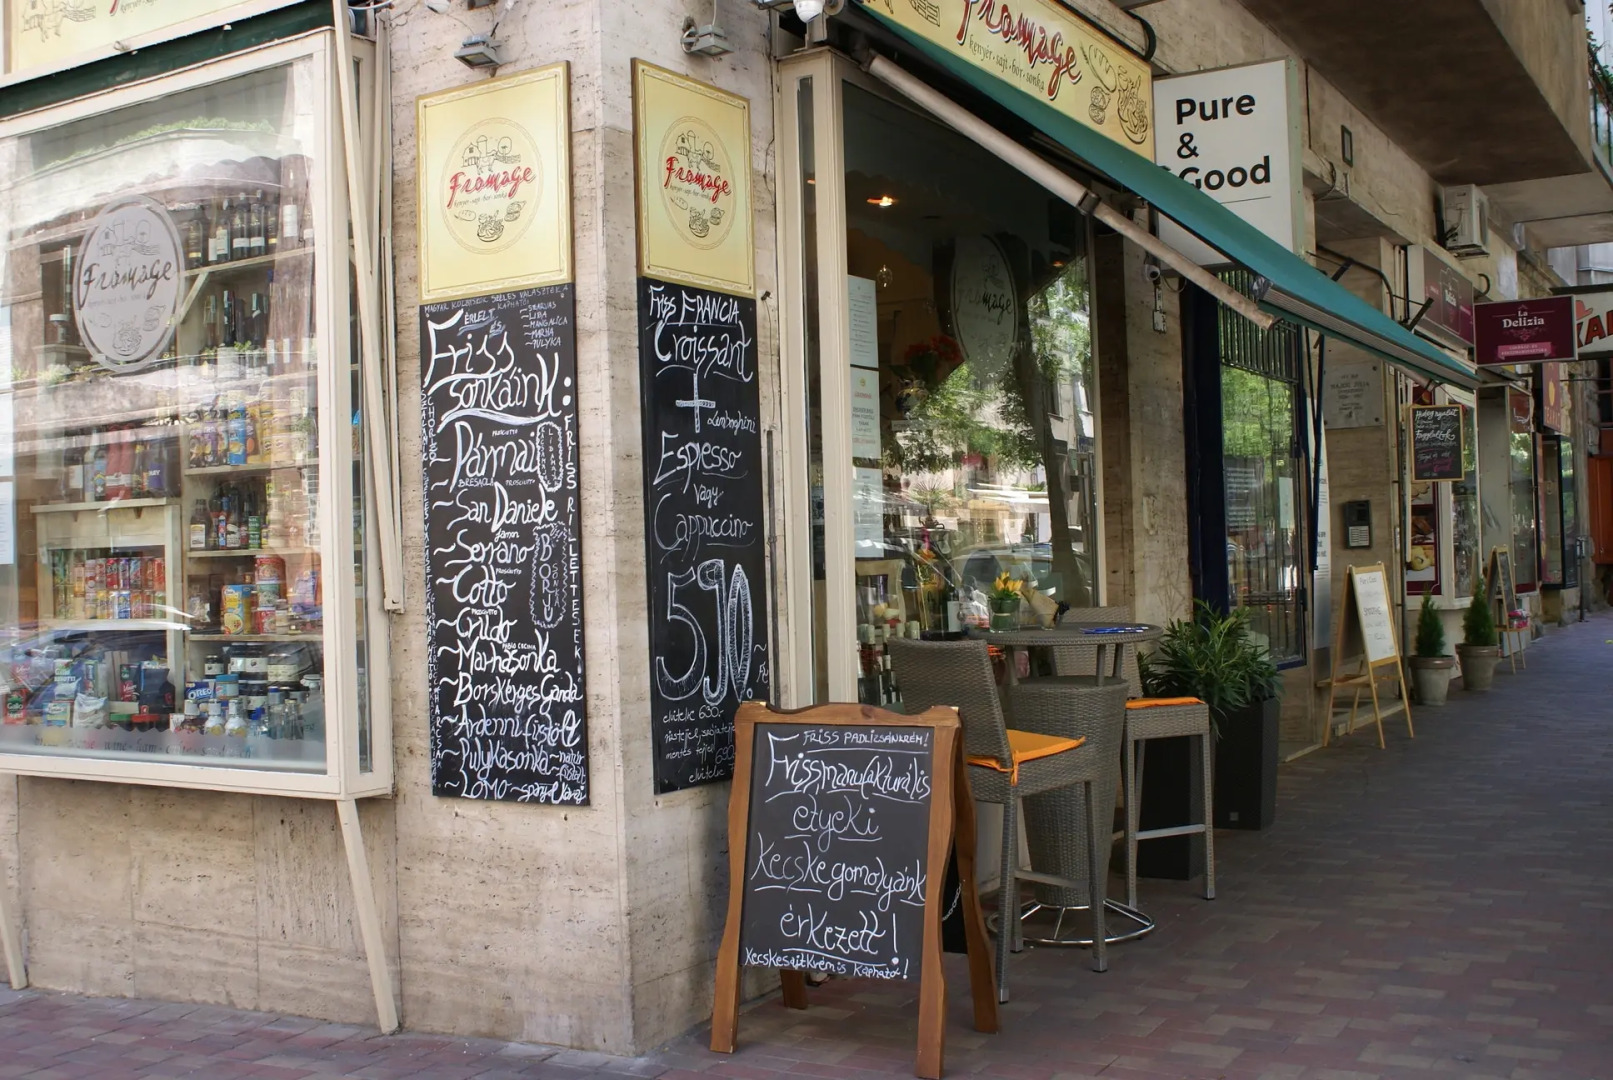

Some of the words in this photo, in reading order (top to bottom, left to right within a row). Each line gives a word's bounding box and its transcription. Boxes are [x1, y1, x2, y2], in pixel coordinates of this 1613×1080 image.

[1175, 94, 1256, 125] Pure
[1176, 132, 1199, 159] &
[446, 166, 536, 209] Fromage
[663, 156, 732, 204] Fromage
[1178, 155, 1271, 190] Good
[79, 258, 172, 310] Fromage
[528, 311, 548, 320] LIBA
[649, 285, 677, 320] Friss
[679, 290, 740, 326] FRANCIA
[1502, 316, 1545, 328] Delizia
[423, 309, 515, 389] Friss
[530, 328, 554, 338] MARHA
[532, 337, 562, 348] PULYKA
[653, 320, 753, 382] Croissant
[449, 421, 539, 493] Pármai
[564, 413, 577, 489] FRISS
[652, 431, 742, 494] Espresso
[458, 477, 494, 488] BRESAOLA
[447, 488, 492, 530] San
[491, 481, 559, 533] Daniele
[445, 529, 536, 567] Serrano
[654, 493, 754, 564] Cappuccino
[452, 564, 516, 607] Cotto
[455, 605, 518, 644] Crudo
[457, 628, 561, 677] Marhasonka
[188, 688, 213, 700] OREO
[454, 703, 523, 739] Ardenni
[803, 728, 840, 746] FRISS
